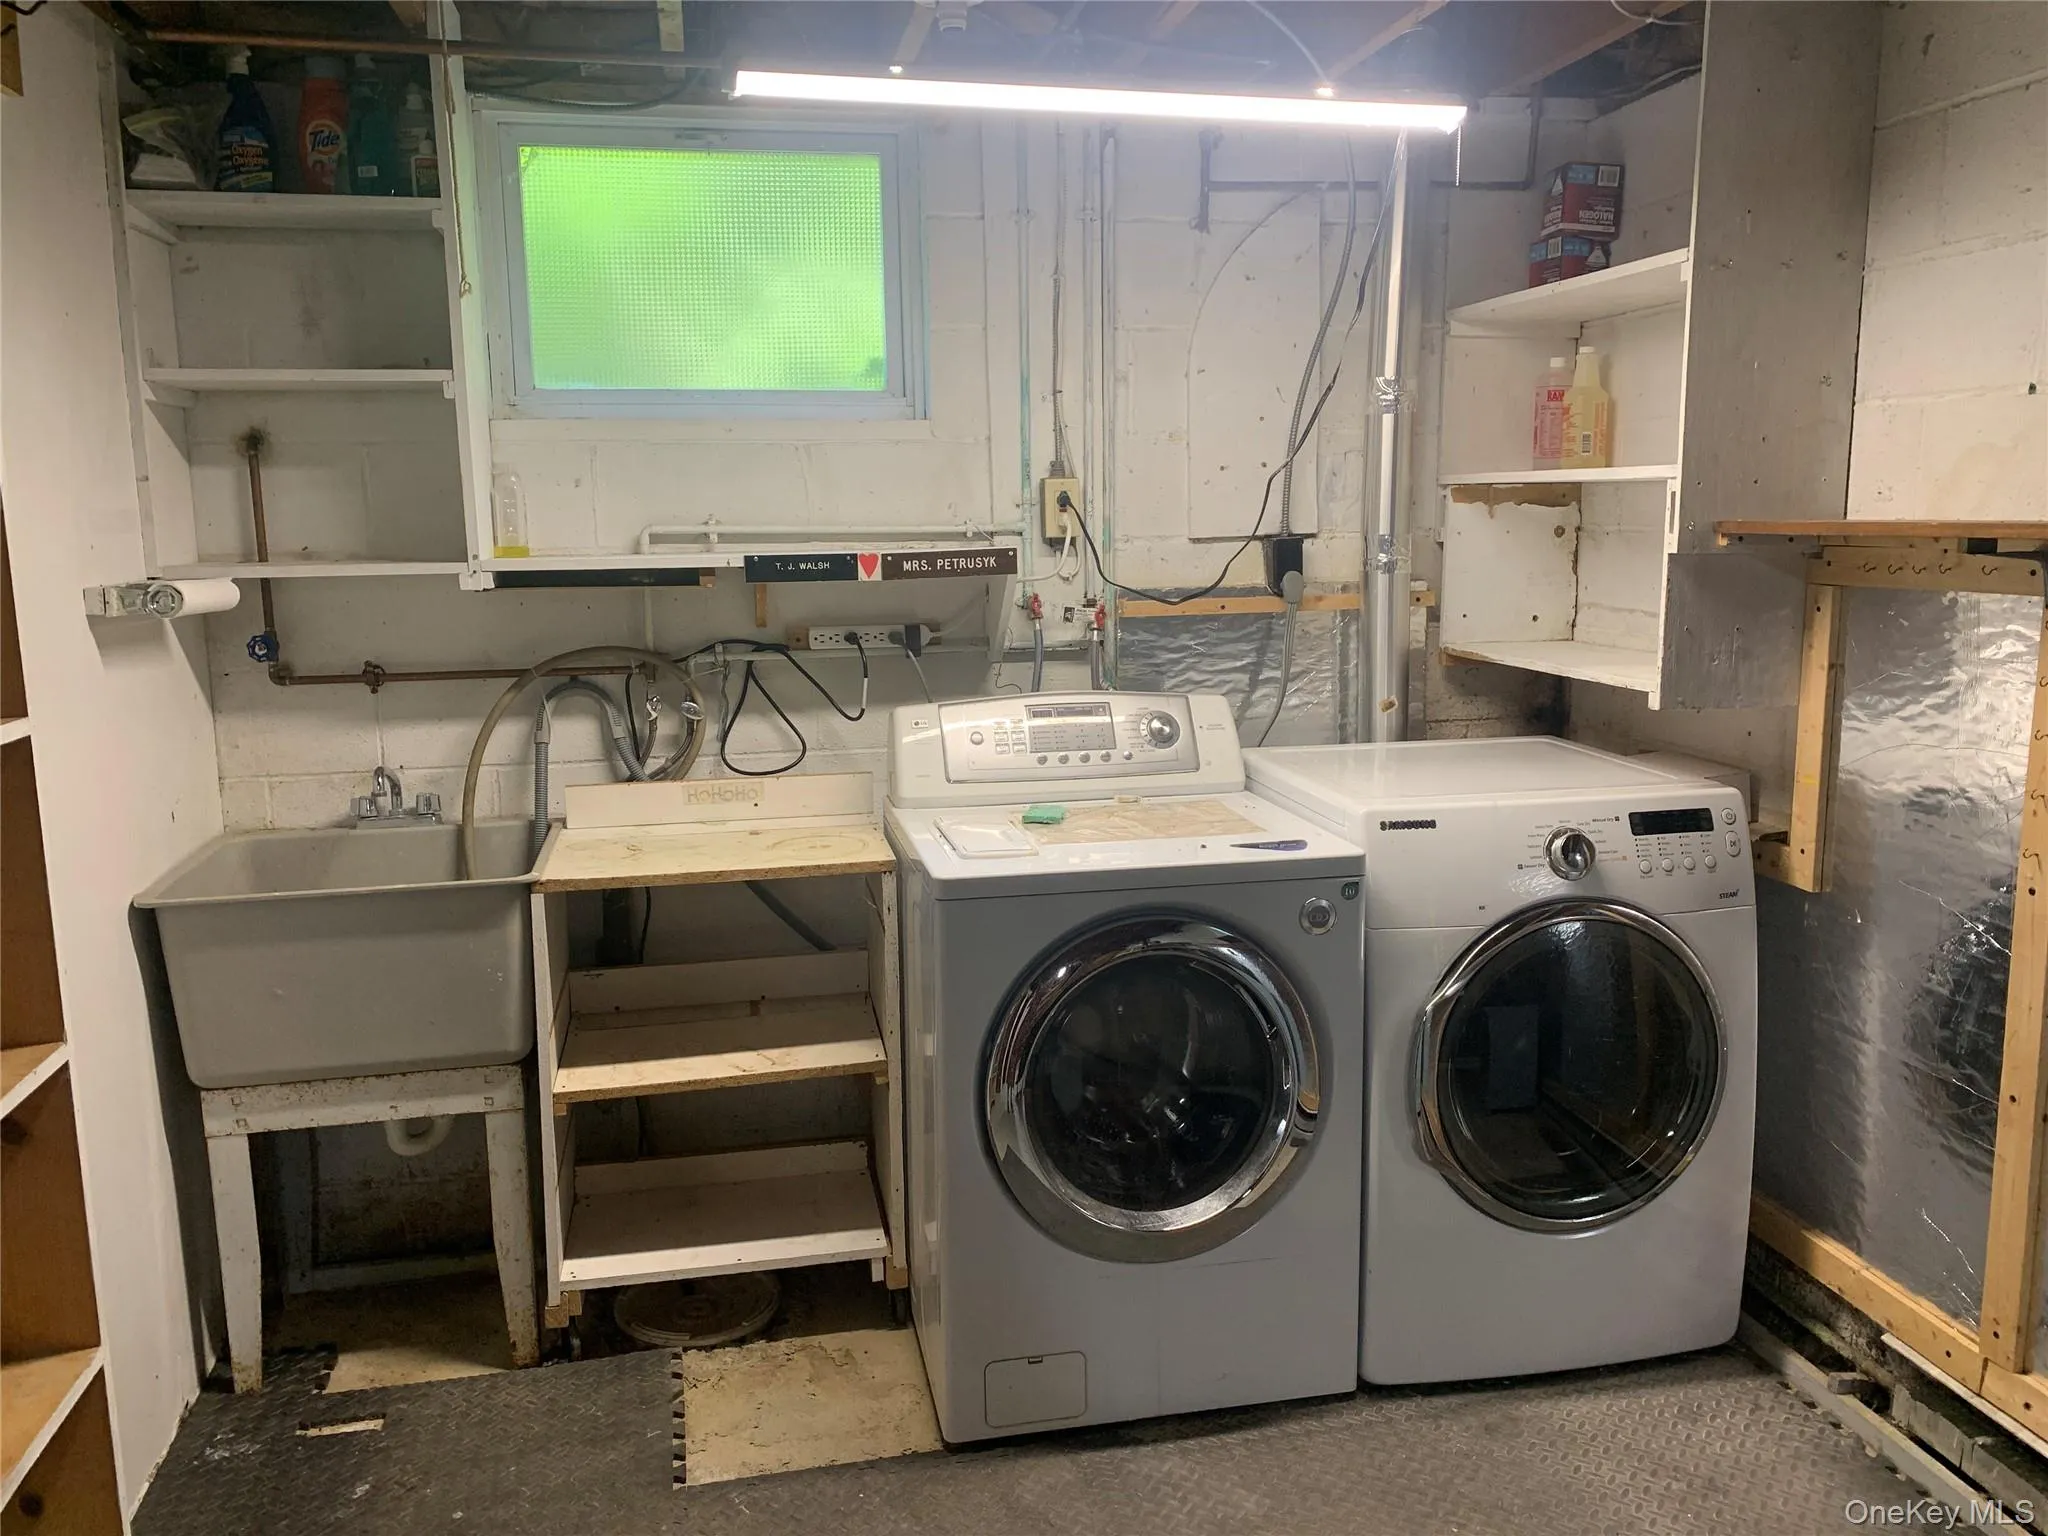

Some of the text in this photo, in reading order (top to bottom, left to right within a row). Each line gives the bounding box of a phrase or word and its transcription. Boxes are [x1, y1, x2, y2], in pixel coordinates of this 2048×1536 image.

[309, 130, 340, 152] Tide
[775, 561, 831, 570] T. J. WALSH
[903, 556, 997, 572] MRS. PETRUSYK
[1379, 819, 1437, 831] SAMSUNG
[1719, 891, 1737, 899] STEAM
